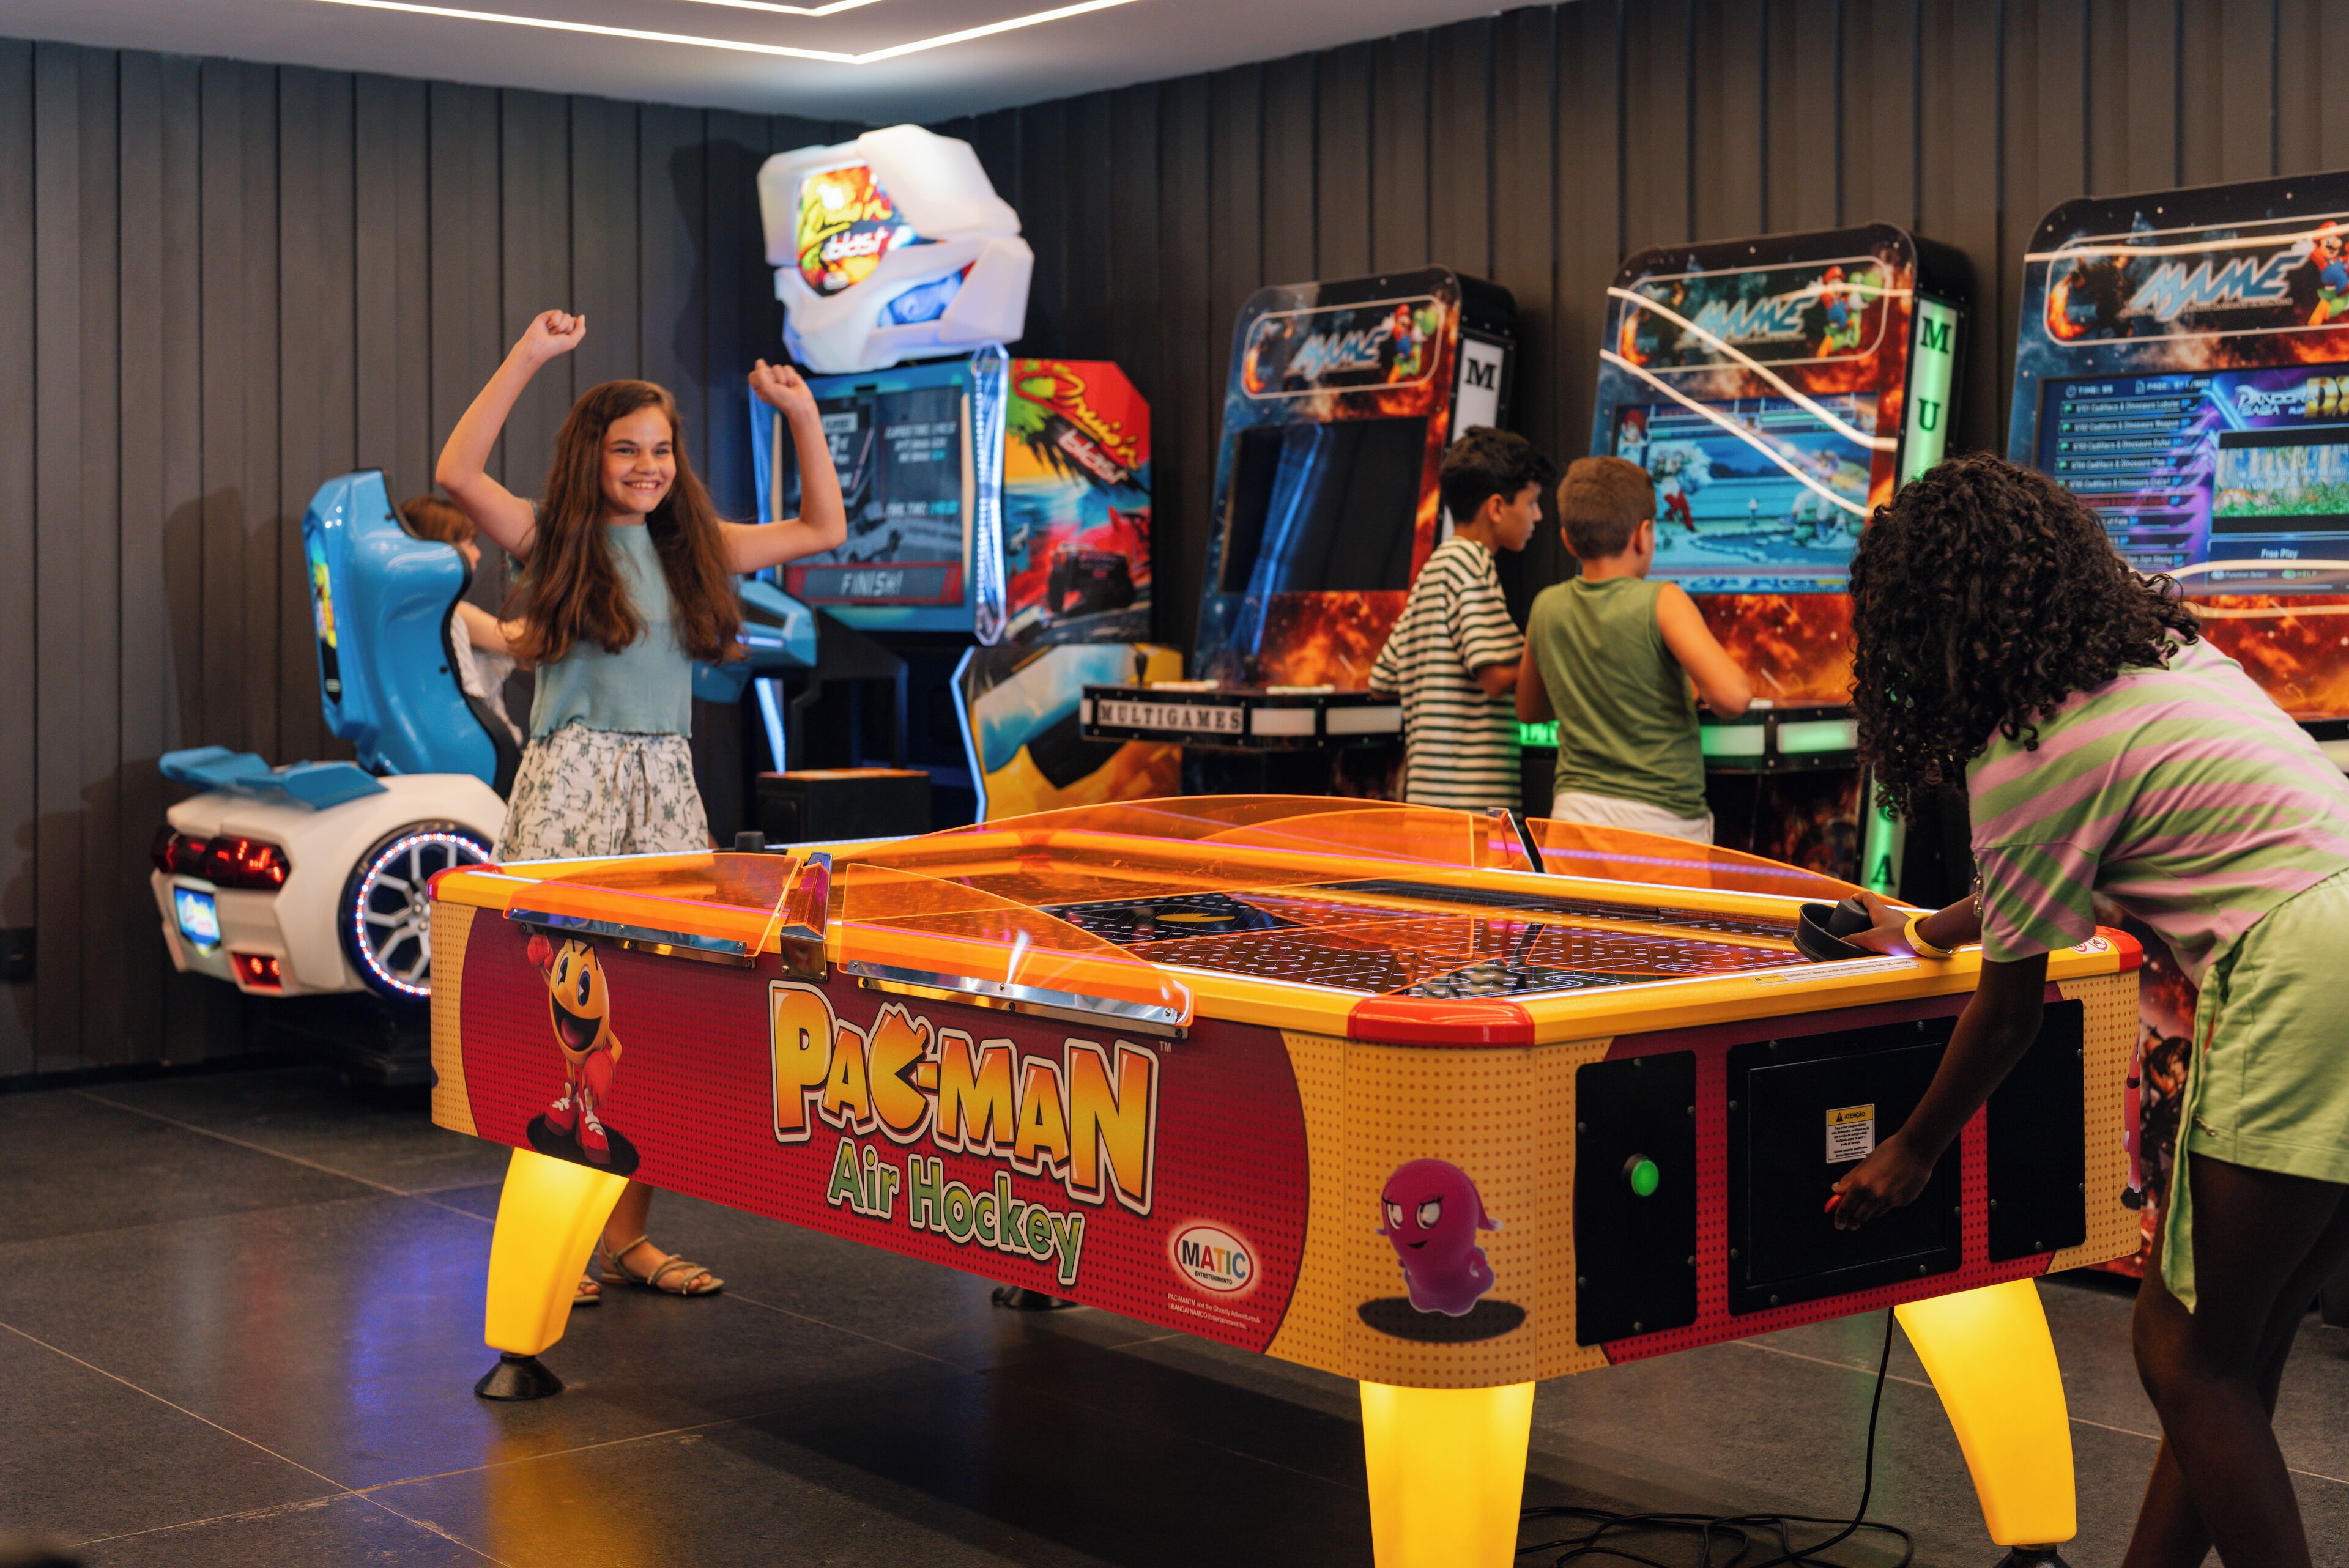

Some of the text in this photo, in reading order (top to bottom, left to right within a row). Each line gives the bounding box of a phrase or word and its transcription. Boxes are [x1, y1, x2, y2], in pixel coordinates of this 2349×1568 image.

[2126, 252, 2311, 322] MAME
[1681, 296, 1819, 353] MAME
[1290, 329, 1392, 382] MAME
[1057, 427, 1130, 485] blast
[1100, 703, 1241, 730] MULTIGAMES
[1159, 1041, 1171, 1052] TM
[769, 980, 1159, 1216] PAC-MAN
[1844, 1111, 1866, 1120] ATENÇÃO
[828, 1137, 1085, 1285] Air Hockey
[1182, 1240, 1246, 1279] MATIC
[1194, 1270, 1233, 1285] ENTRETENIMENTO
[1190, 1308, 1208, 1319] NAMCO
[1208, 1313, 1239, 1328] Entertainment
[1213, 1305, 1231, 1317] Ghostly
